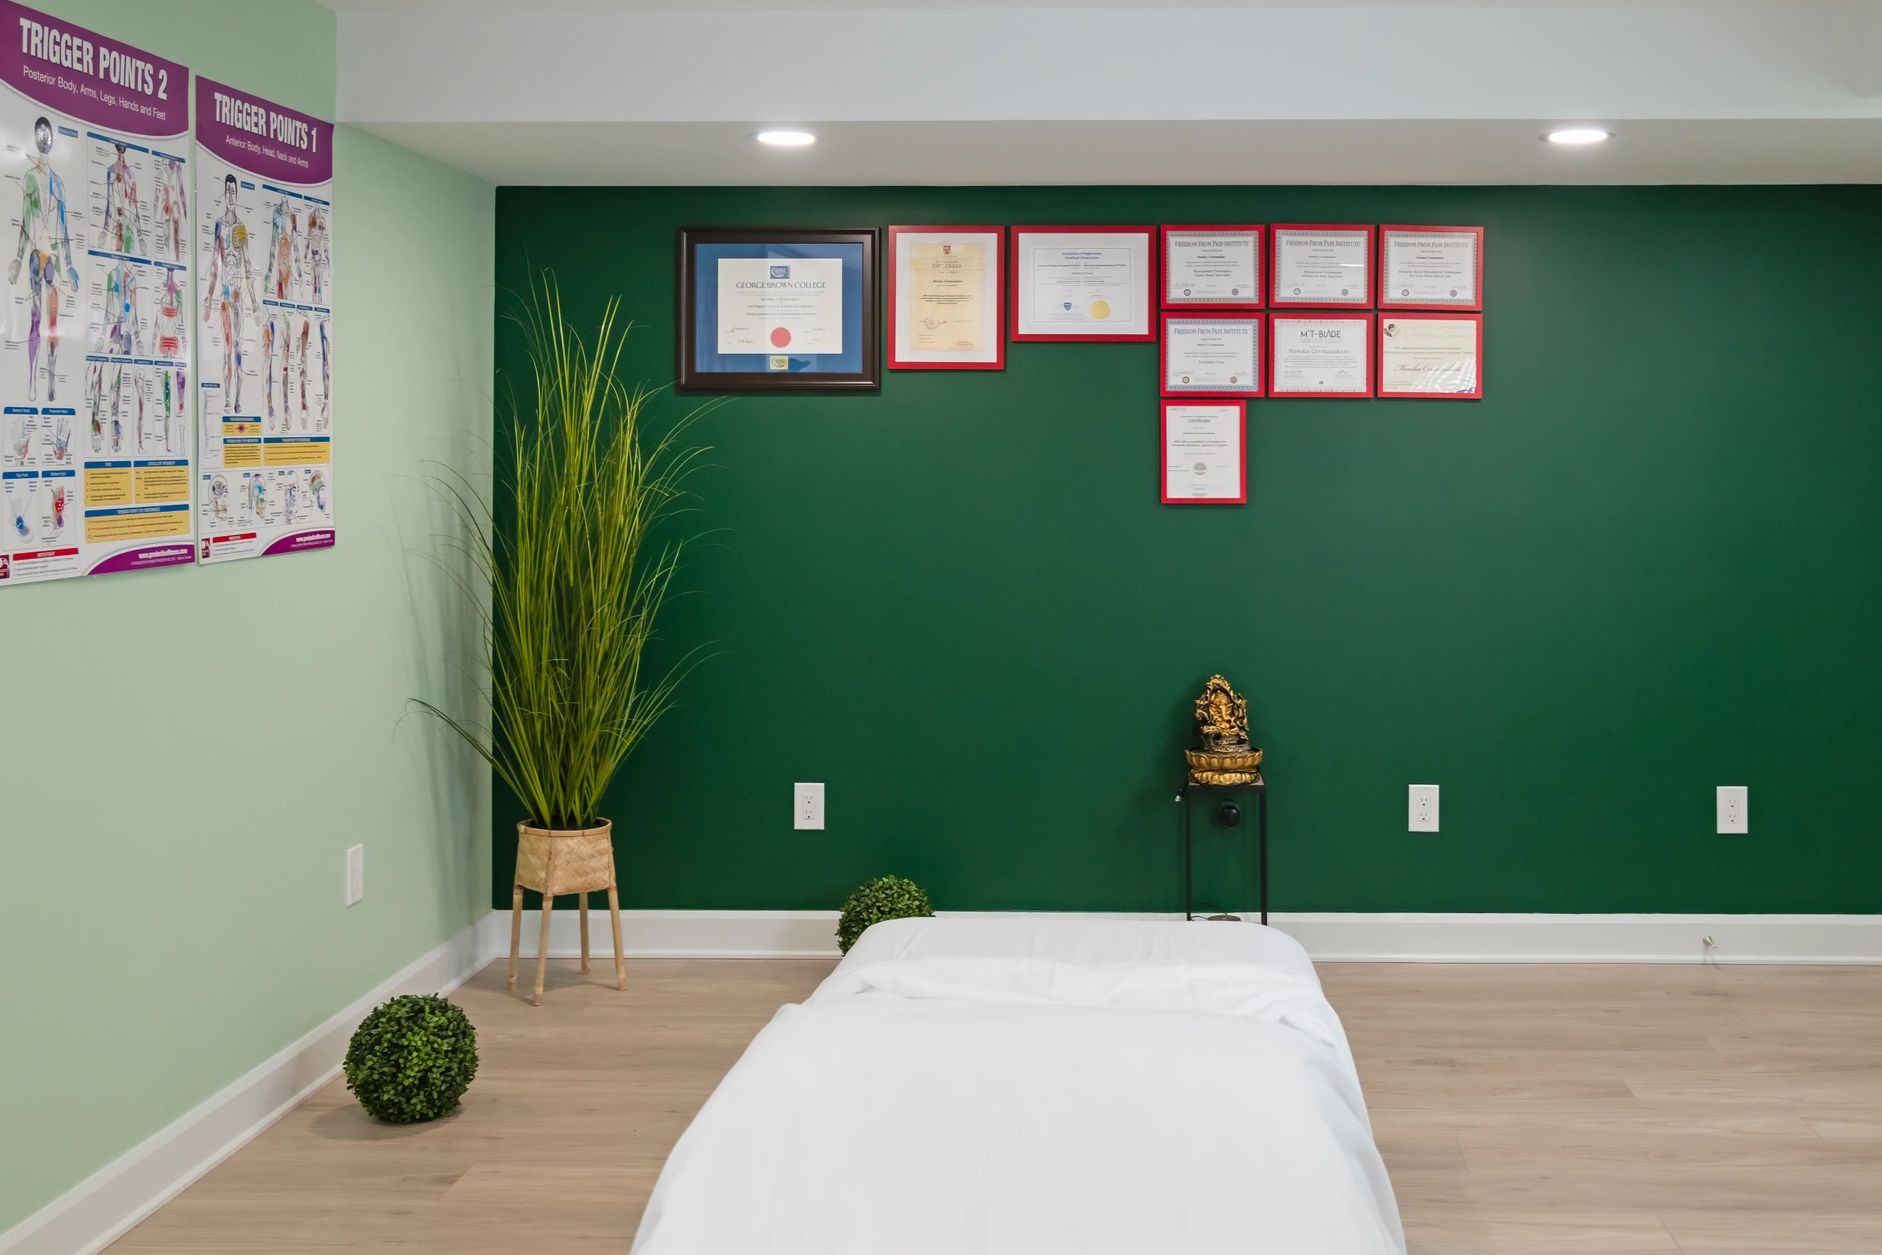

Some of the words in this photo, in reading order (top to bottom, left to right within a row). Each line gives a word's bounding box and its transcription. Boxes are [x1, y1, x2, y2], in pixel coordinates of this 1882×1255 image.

[19, 17, 94, 75] TRIGGER
[98, 46, 154, 96] POINTS
[157, 69, 168, 101] 2
[23, 65, 55, 87] Posterior
[57, 76, 79, 95] Body,
[80, 84, 99, 101] Arms,
[99, 90, 117, 107] Legs,
[119, 96, 139, 112] Hands
[140, 104, 151, 116] and
[152, 107, 166, 120] Feet
[214, 91, 267, 137] TRIGGER
[269, 111, 308, 150] POINTS
[311, 127, 317, 153] 1
[225, 135, 246, 149] Anterior
[288, 155, 297, 164] and
[297, 158, 309, 168] Arms
[735, 281, 767, 289] GEORGE
[766, 281, 793, 289] BROWN
[793, 281, 827, 289] COLLEGE
